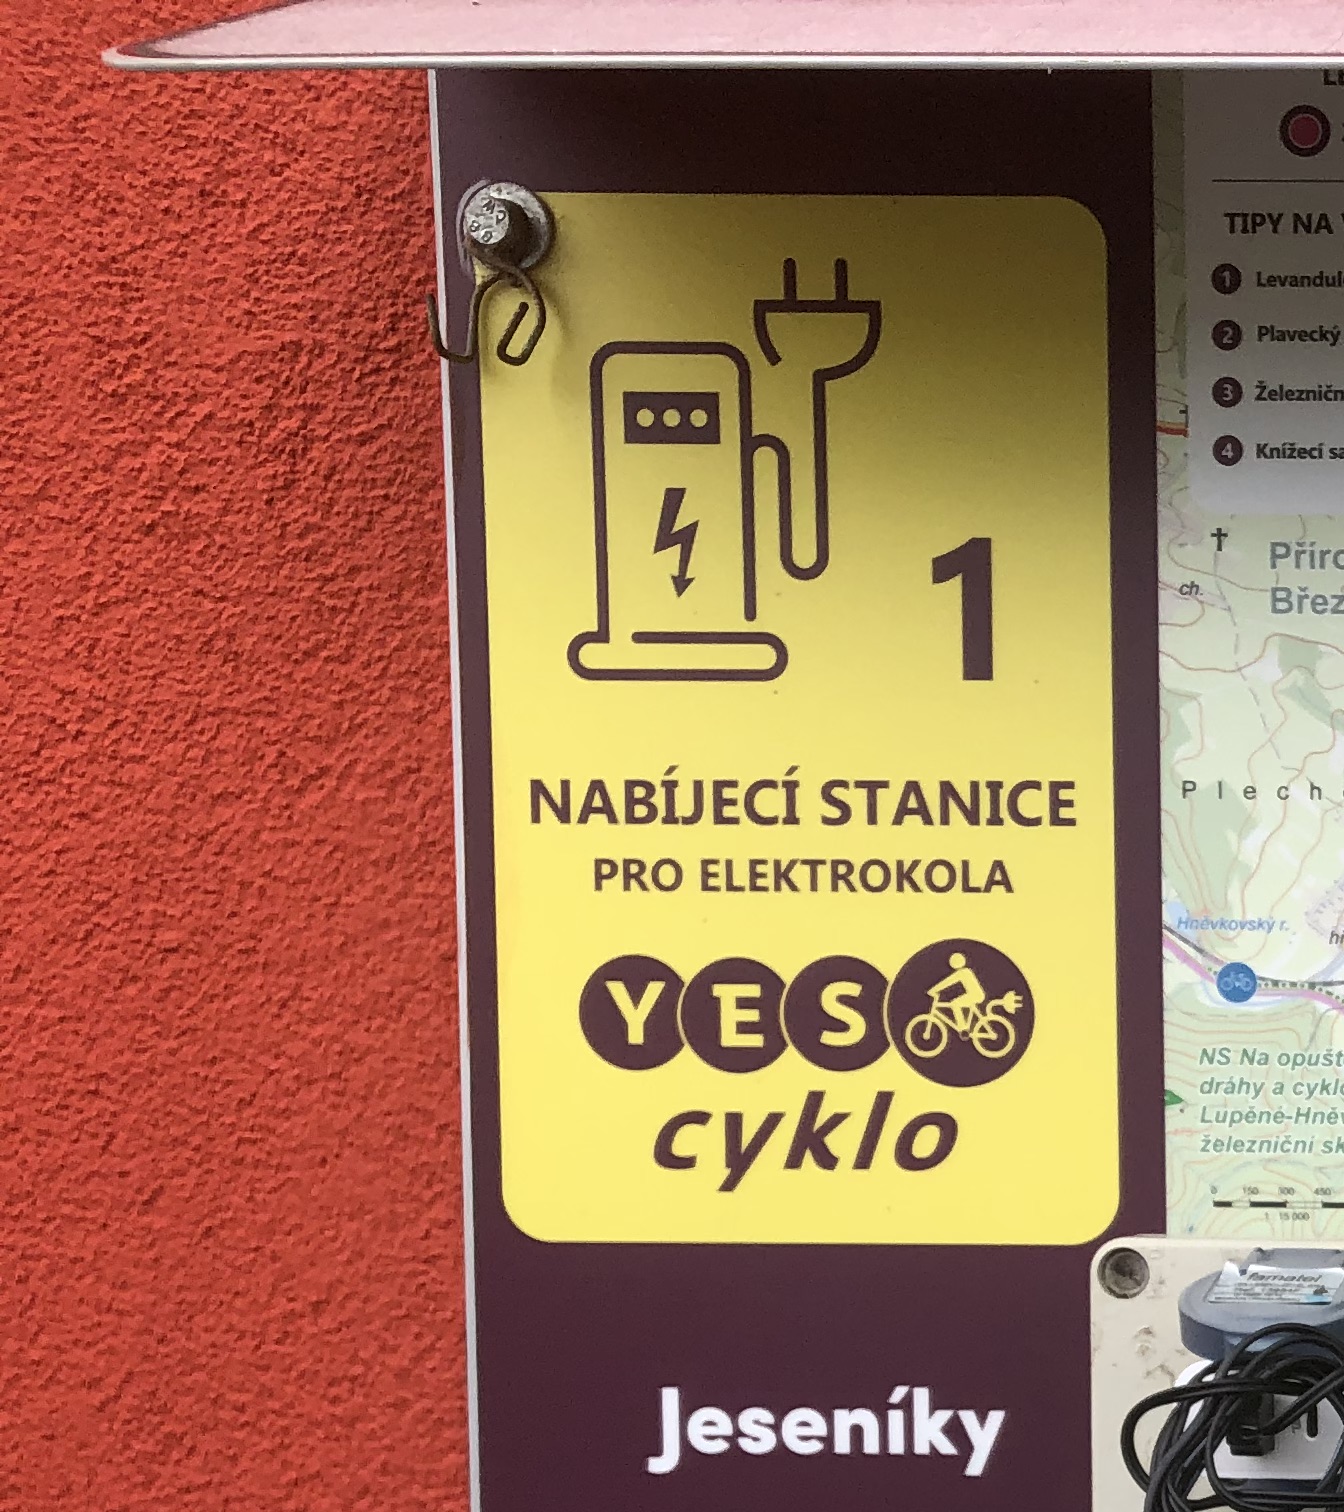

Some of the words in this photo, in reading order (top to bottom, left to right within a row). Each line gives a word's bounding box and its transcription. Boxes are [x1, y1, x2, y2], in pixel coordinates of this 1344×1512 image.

[1223, 212, 1284, 235] TIPY
[1292, 212, 1334, 235] NA
[1257, 324, 1342, 347] Plavecký
[1255, 441, 1324, 460] Knížecí
[932, 537, 993, 681] 1
[529, 765, 801, 826] NABÍJECÍ
[820, 779, 1077, 828] STANICE
[593, 857, 683, 892] PRO
[700, 858, 1015, 894] ELEKTROKOLA
[605, 980, 868, 1049] YES
[1200, 1049, 1232, 1067] NS
[1239, 1049, 1270, 1067] Na
[652, 1089, 959, 1192] cyklo
[647, 1385, 1006, 1477] Jeseníky
